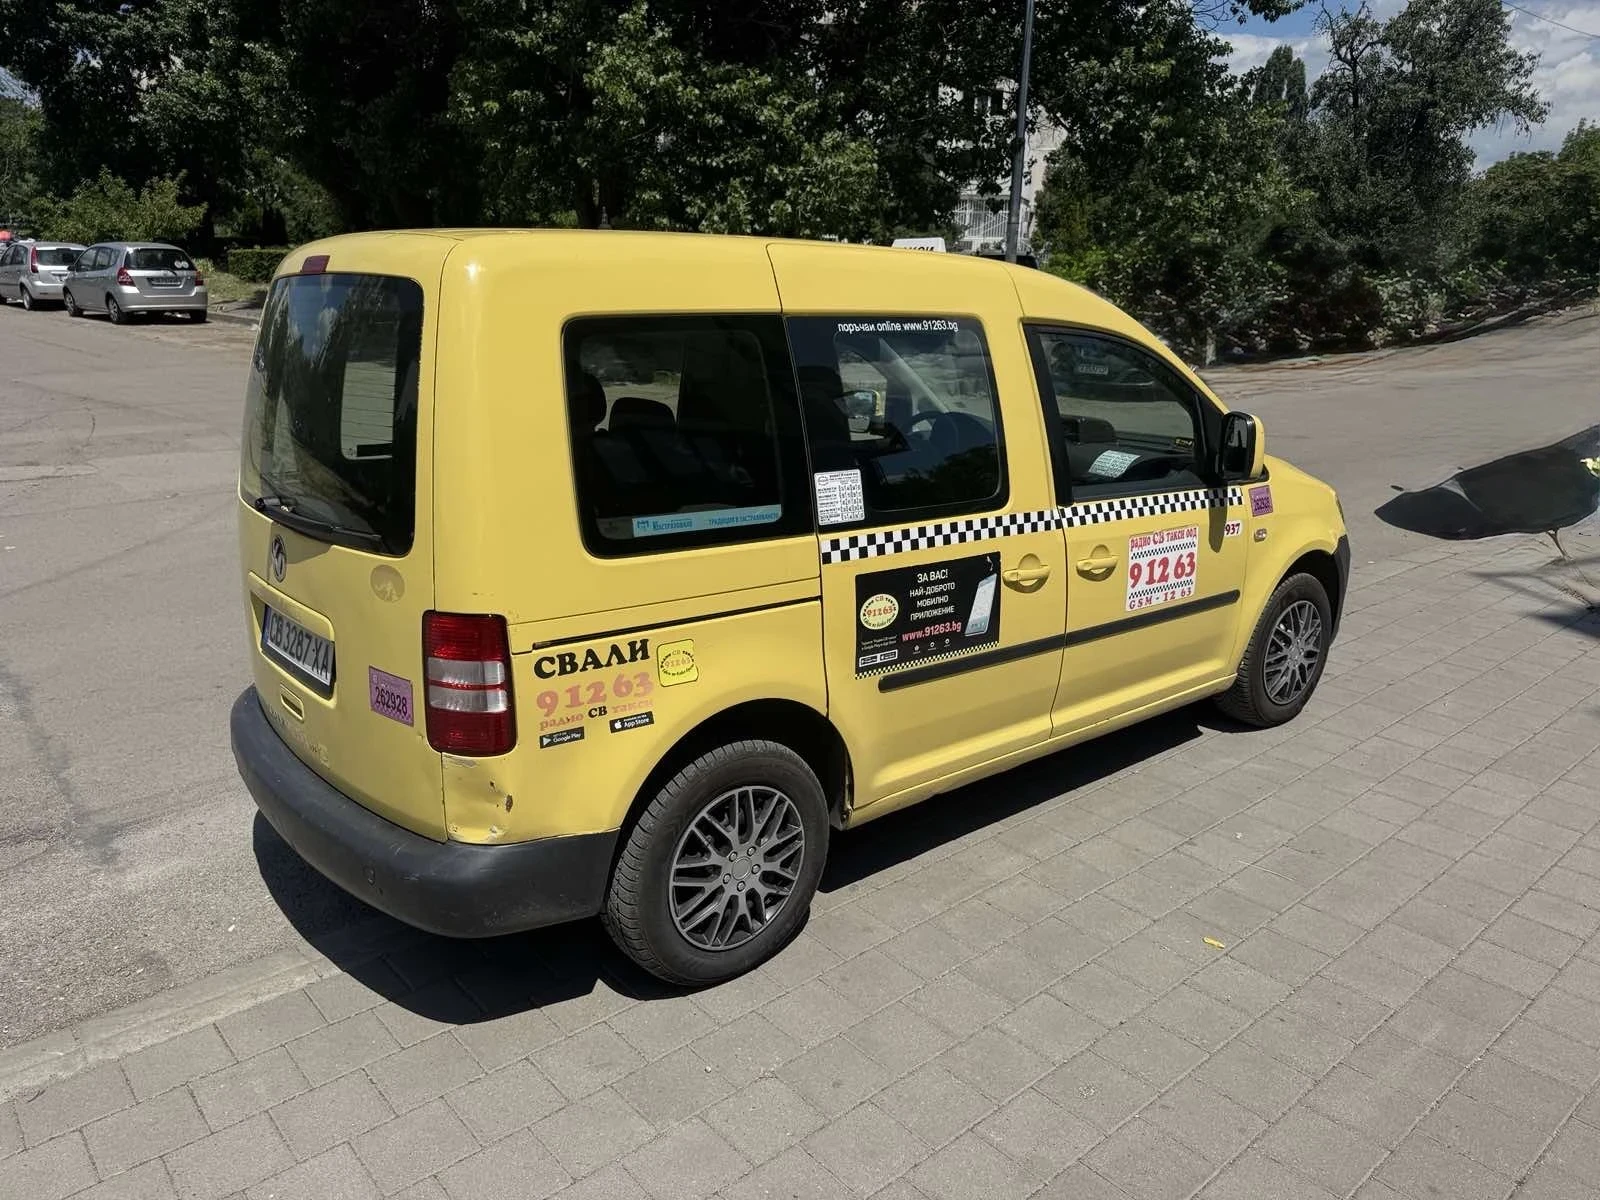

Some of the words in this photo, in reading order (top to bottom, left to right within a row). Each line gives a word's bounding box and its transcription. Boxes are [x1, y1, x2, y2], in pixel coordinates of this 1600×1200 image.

[877, 320, 901, 332] online
[902, 320, 959, 332] www.91263.bg
[1130, 537, 1151, 551] радио
[1167, 530, 1185, 543] такси
[917, 572, 928, 583] ЗА
[930, 568, 949, 581] ВАС!
[909, 582, 956, 598] НАЙ-ДОБРОТО
[916, 595, 949, 608] МОБИЛНО
[1129, 598, 1152, 610] GSM
[910, 606, 955, 621] ПРИЛОЖЕНИЕ
[902, 621, 962, 642] www.91263.bg
[283, 622, 312, 664] 3287
[534, 638, 650, 679] СВАЛИ
[375, 687, 408, 716] 262928
[624, 720, 635, 729] App
[635, 716, 650, 726] Store
[553, 732, 571, 743] Google
[571, 732, 582, 741] Play
